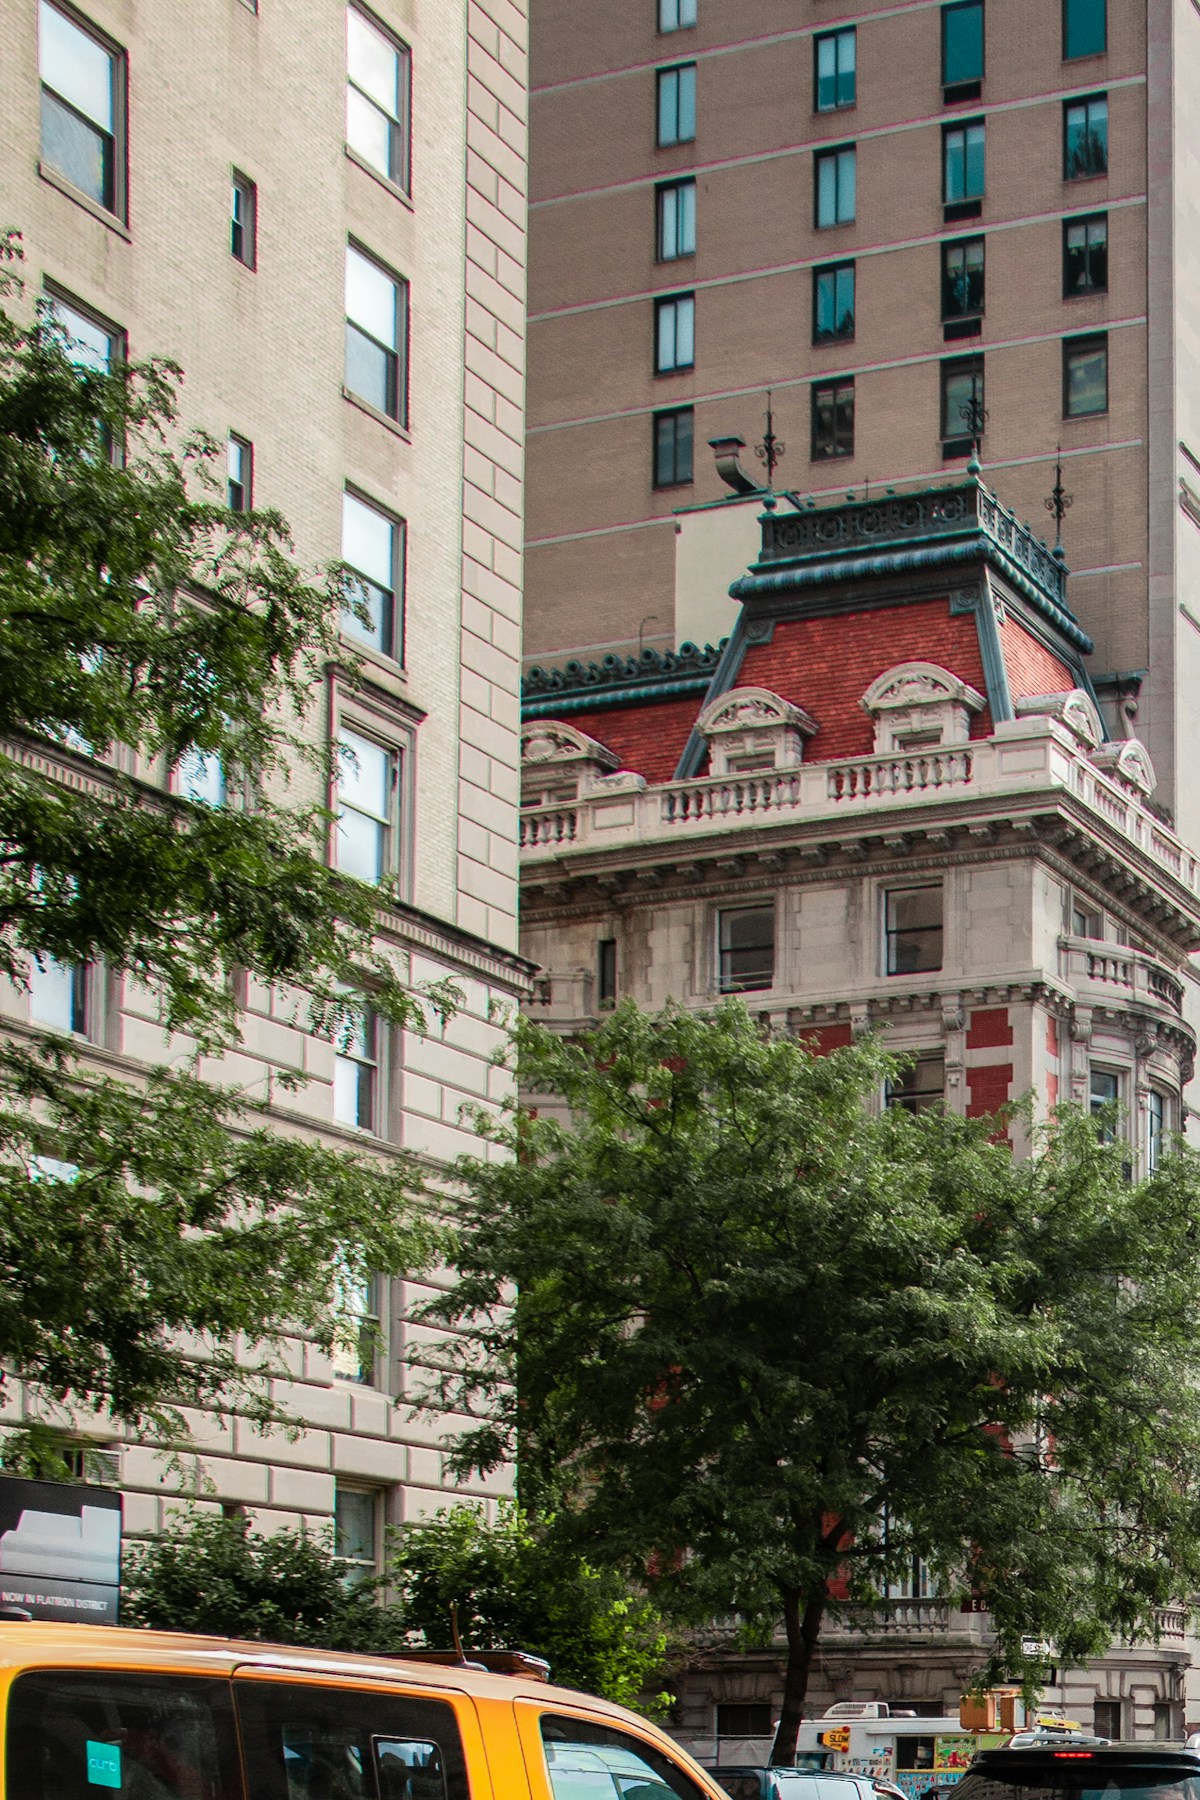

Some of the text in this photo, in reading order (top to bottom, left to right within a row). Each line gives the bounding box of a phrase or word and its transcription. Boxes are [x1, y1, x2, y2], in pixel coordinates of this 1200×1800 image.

[1, 1591, 24, 1603] NOW
[25, 1593, 36, 1604] IN
[88, 1758, 118, 1772] curb
